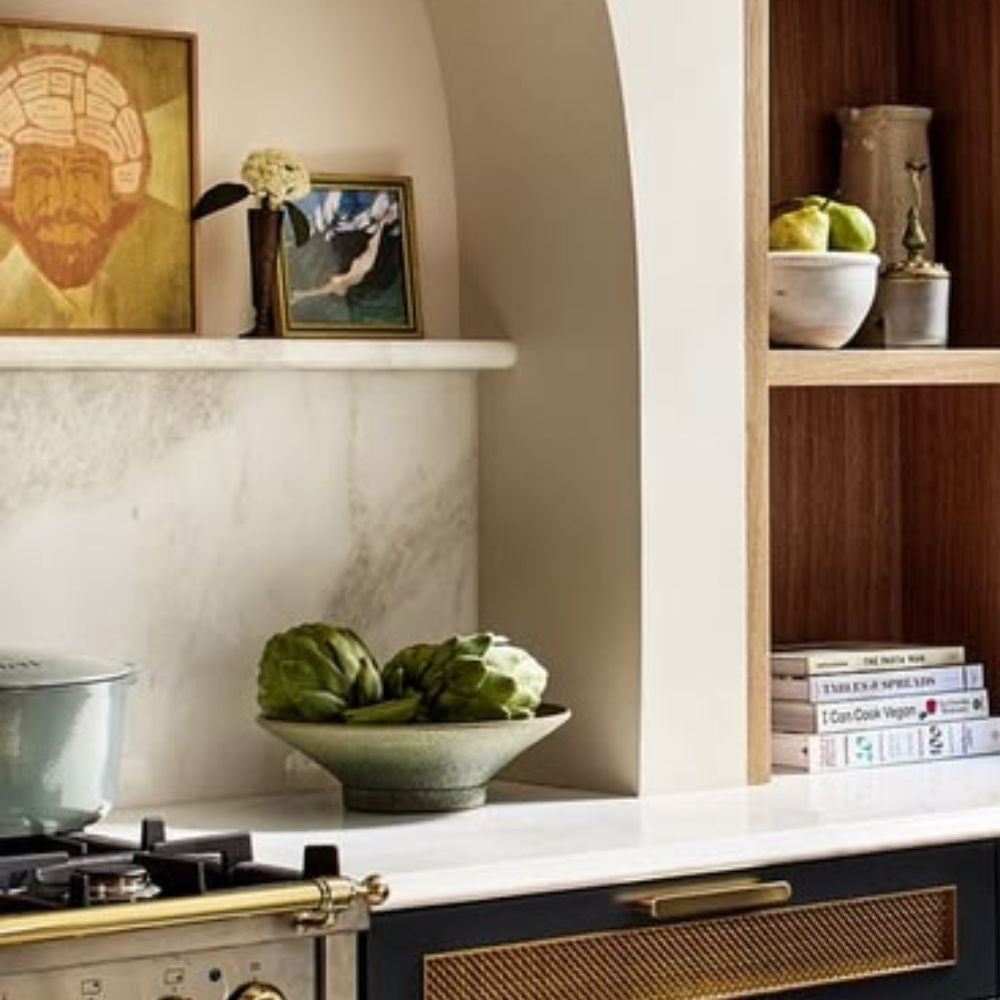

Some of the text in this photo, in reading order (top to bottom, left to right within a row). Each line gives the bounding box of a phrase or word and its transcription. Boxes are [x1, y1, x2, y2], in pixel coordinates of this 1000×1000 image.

[823, 705, 917, 725] I Can Cook Vegan
